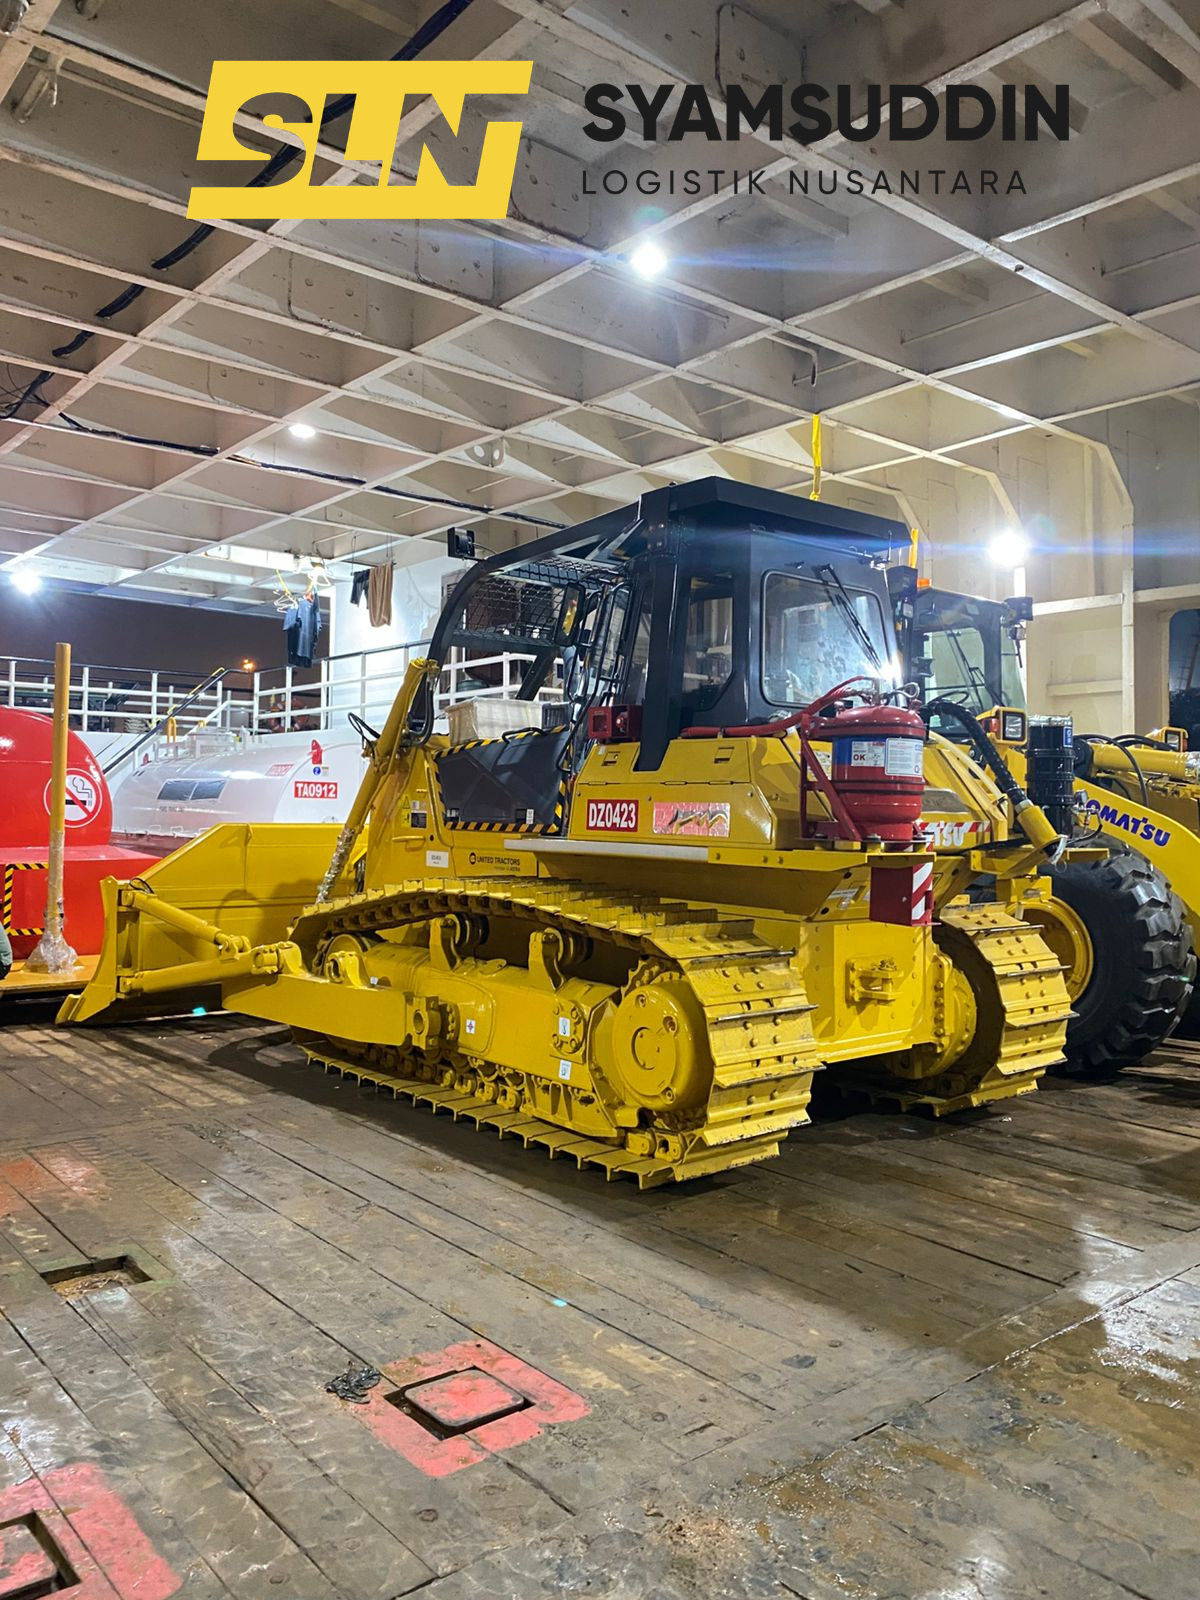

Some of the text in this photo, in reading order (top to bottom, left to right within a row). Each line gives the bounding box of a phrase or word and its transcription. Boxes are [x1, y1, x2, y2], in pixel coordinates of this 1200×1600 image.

[296, 783, 336, 797] TA0912
[589, 803, 636, 828] DZ0423
[1086, 799, 1171, 847] OMATSU
[477, 855, 520, 866] UNITED TRACTORS
